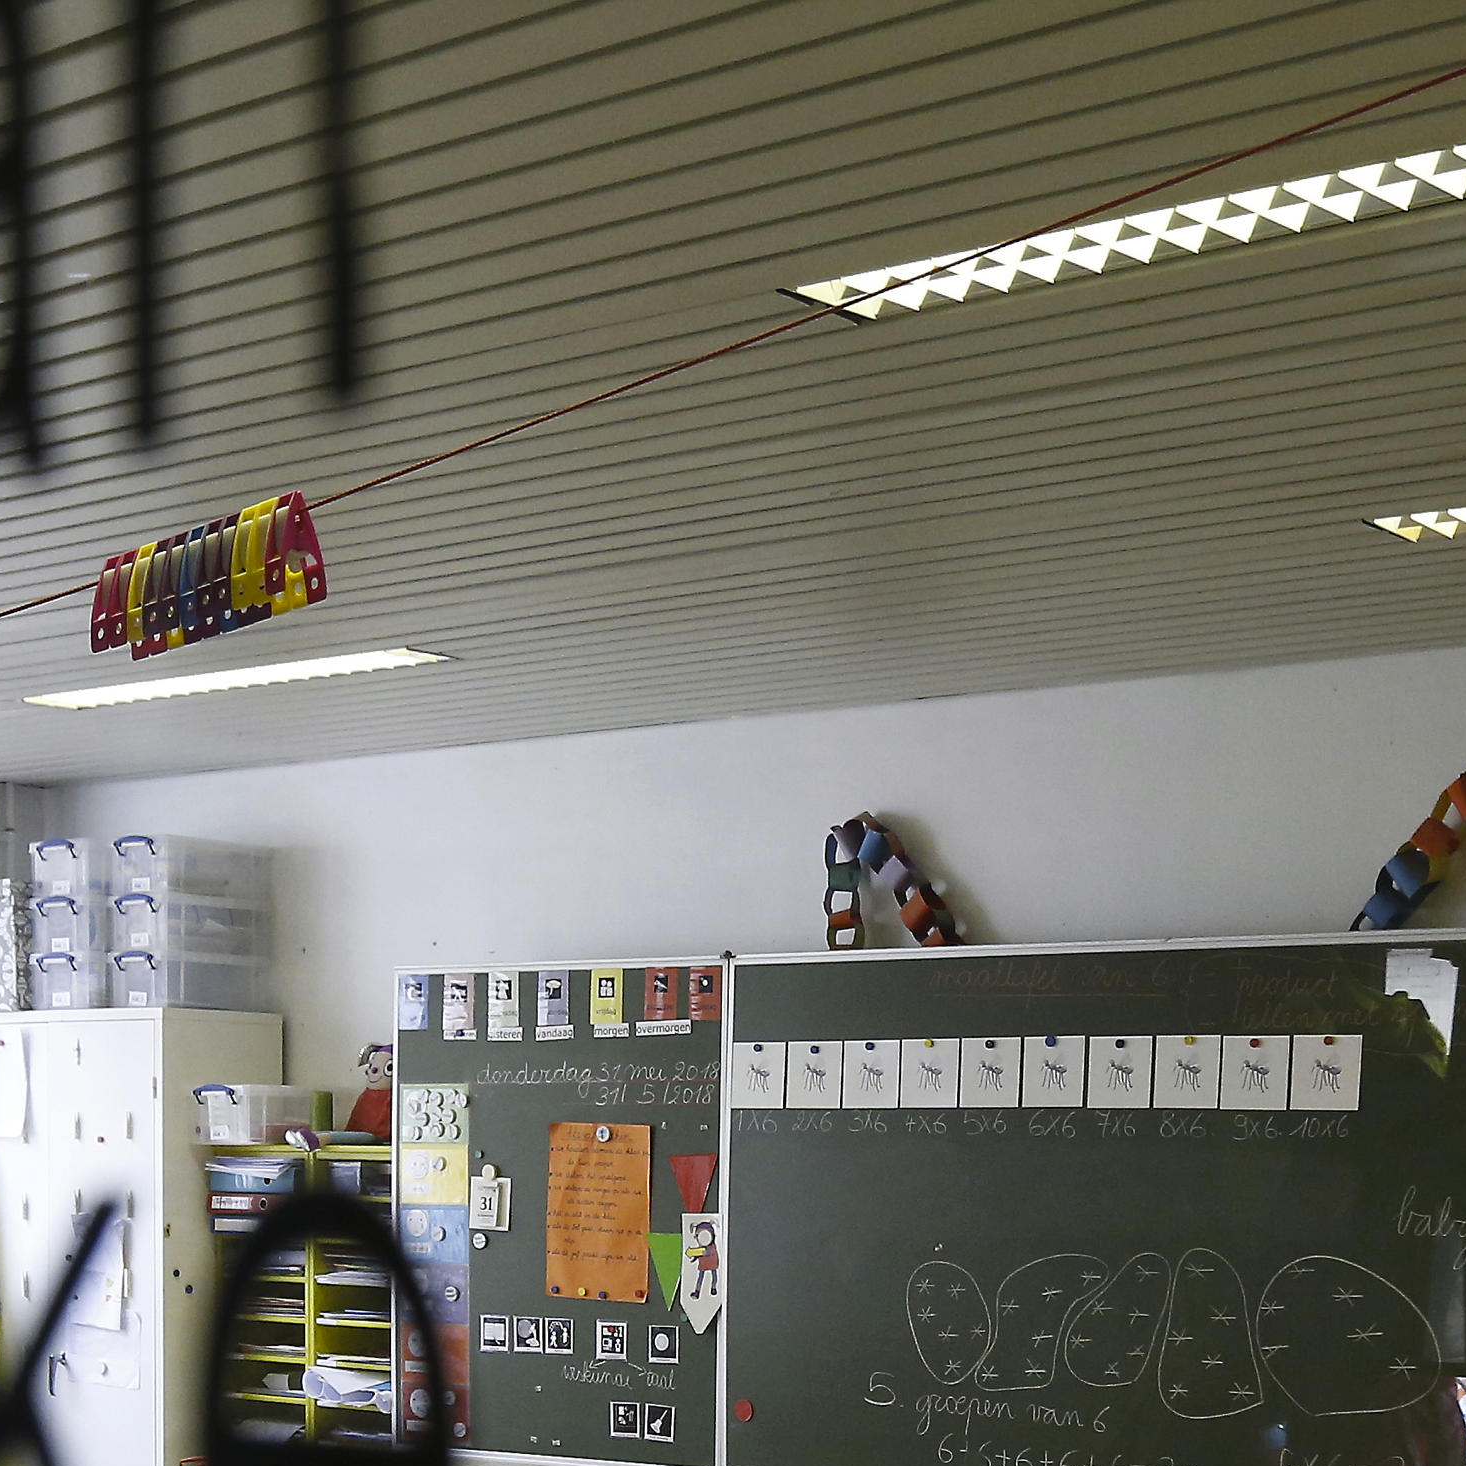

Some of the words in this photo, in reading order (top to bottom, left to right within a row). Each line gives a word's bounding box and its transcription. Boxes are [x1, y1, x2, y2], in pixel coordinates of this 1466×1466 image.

[536, 1027, 574, 1040] vandaag
[594, 1025, 630, 1038] morgen
[635, 1021, 691, 1035] overmorgen
[477, 1060, 593, 1098] donderdag
[598, 1061, 621, 1081] 31
[628, 1063, 668, 1082] mei
[671, 1061, 721, 1082] 2018
[479, 1196, 493, 1211] 31
[646, 1368, 677, 1391] taal
[915, 1394, 1015, 1436] groepen
[1026, 1402, 1085, 1428] van
[1092, 1405, 1111, 1433] 6
